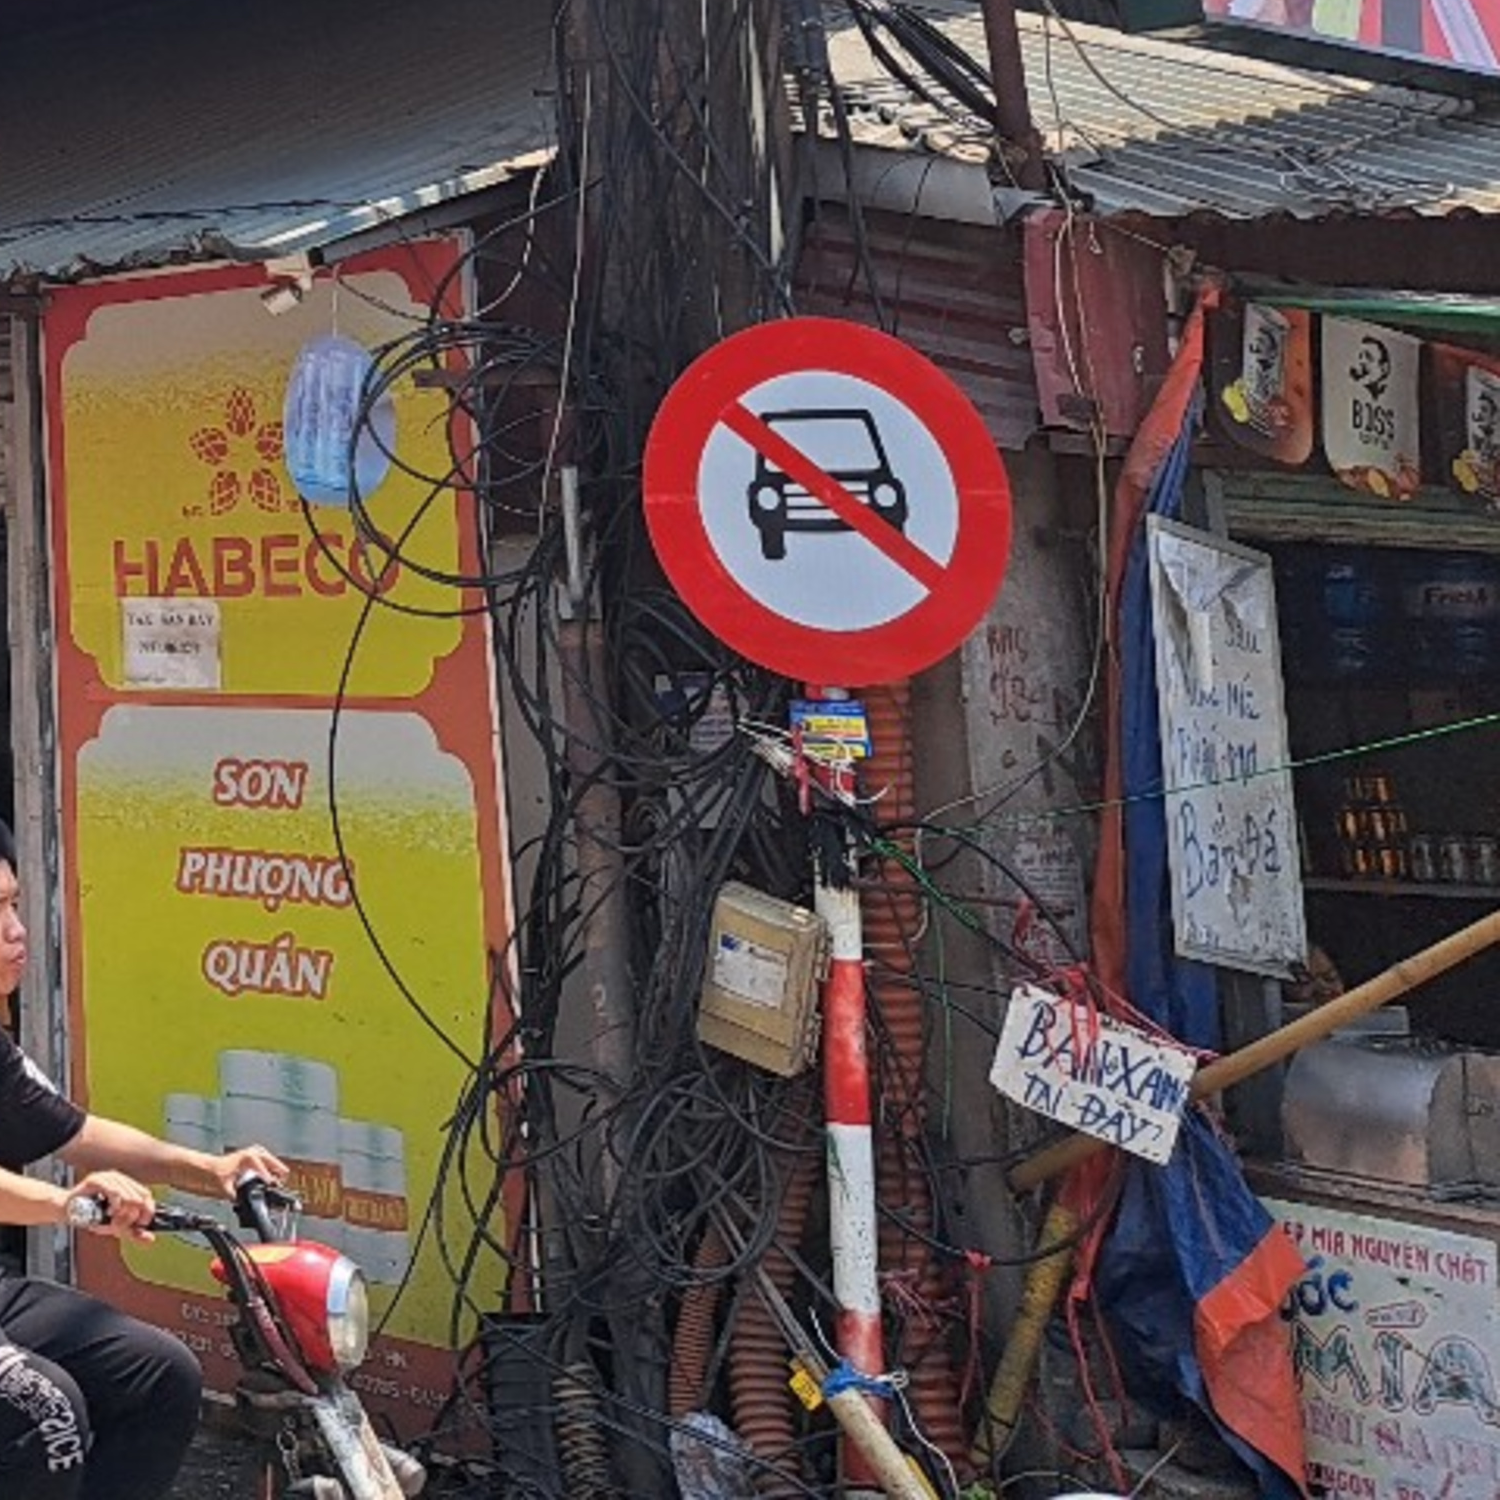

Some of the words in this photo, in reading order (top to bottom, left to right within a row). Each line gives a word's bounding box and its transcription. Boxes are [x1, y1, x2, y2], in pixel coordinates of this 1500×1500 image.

[113, 535, 400, 598] HABECO
[214, 760, 306, 806] SƠN
[179, 849, 354, 910] PHƯỢNG
[202, 935, 331, 997] QUÁN
